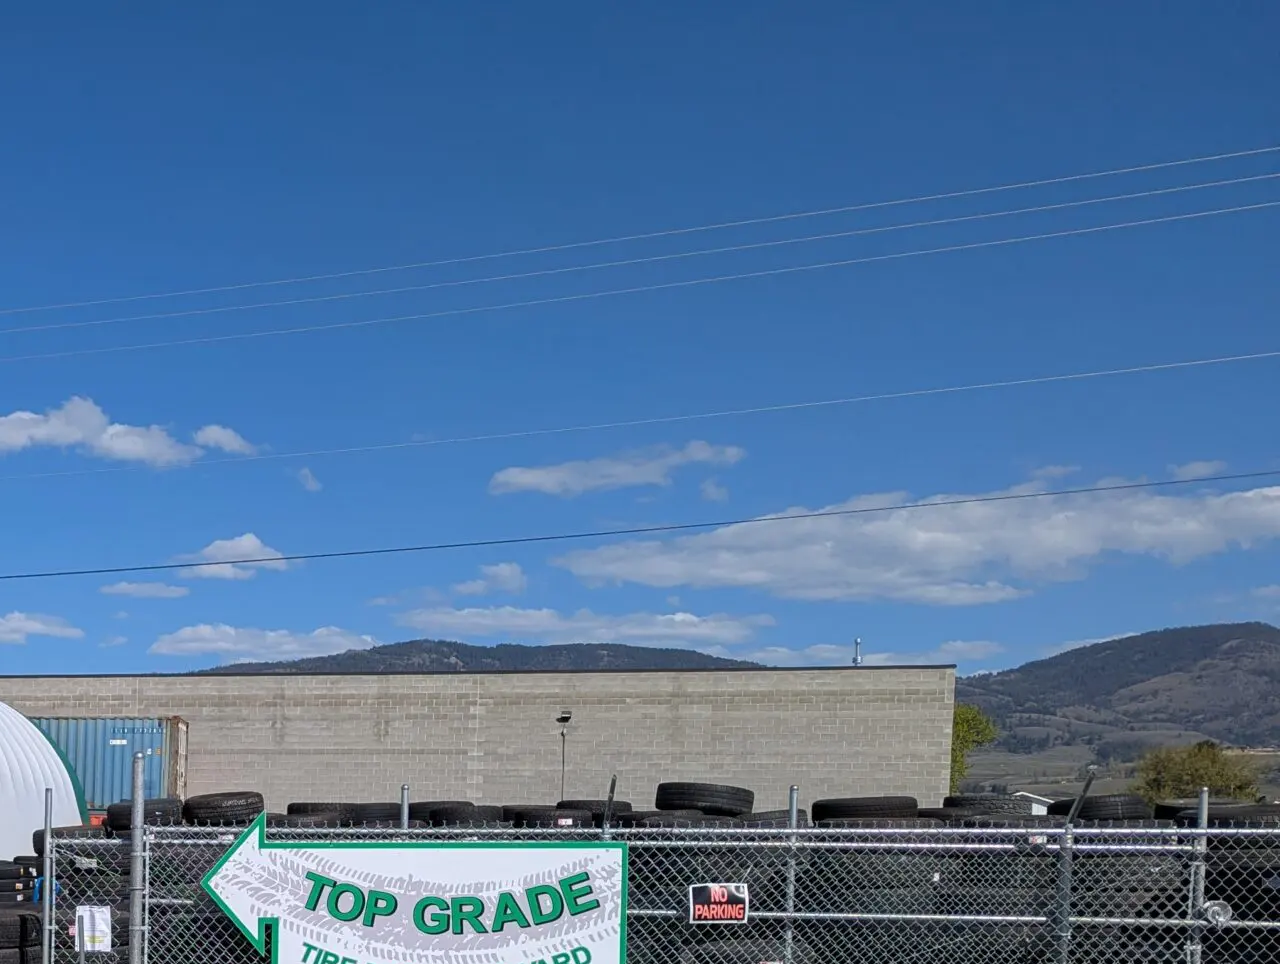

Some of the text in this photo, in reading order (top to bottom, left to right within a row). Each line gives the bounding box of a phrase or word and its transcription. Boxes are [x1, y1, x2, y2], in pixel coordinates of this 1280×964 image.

[304, 870, 600, 935] TOP GRADE
[710, 886, 728, 903] NO
[694, 904, 745, 919] PARKING
